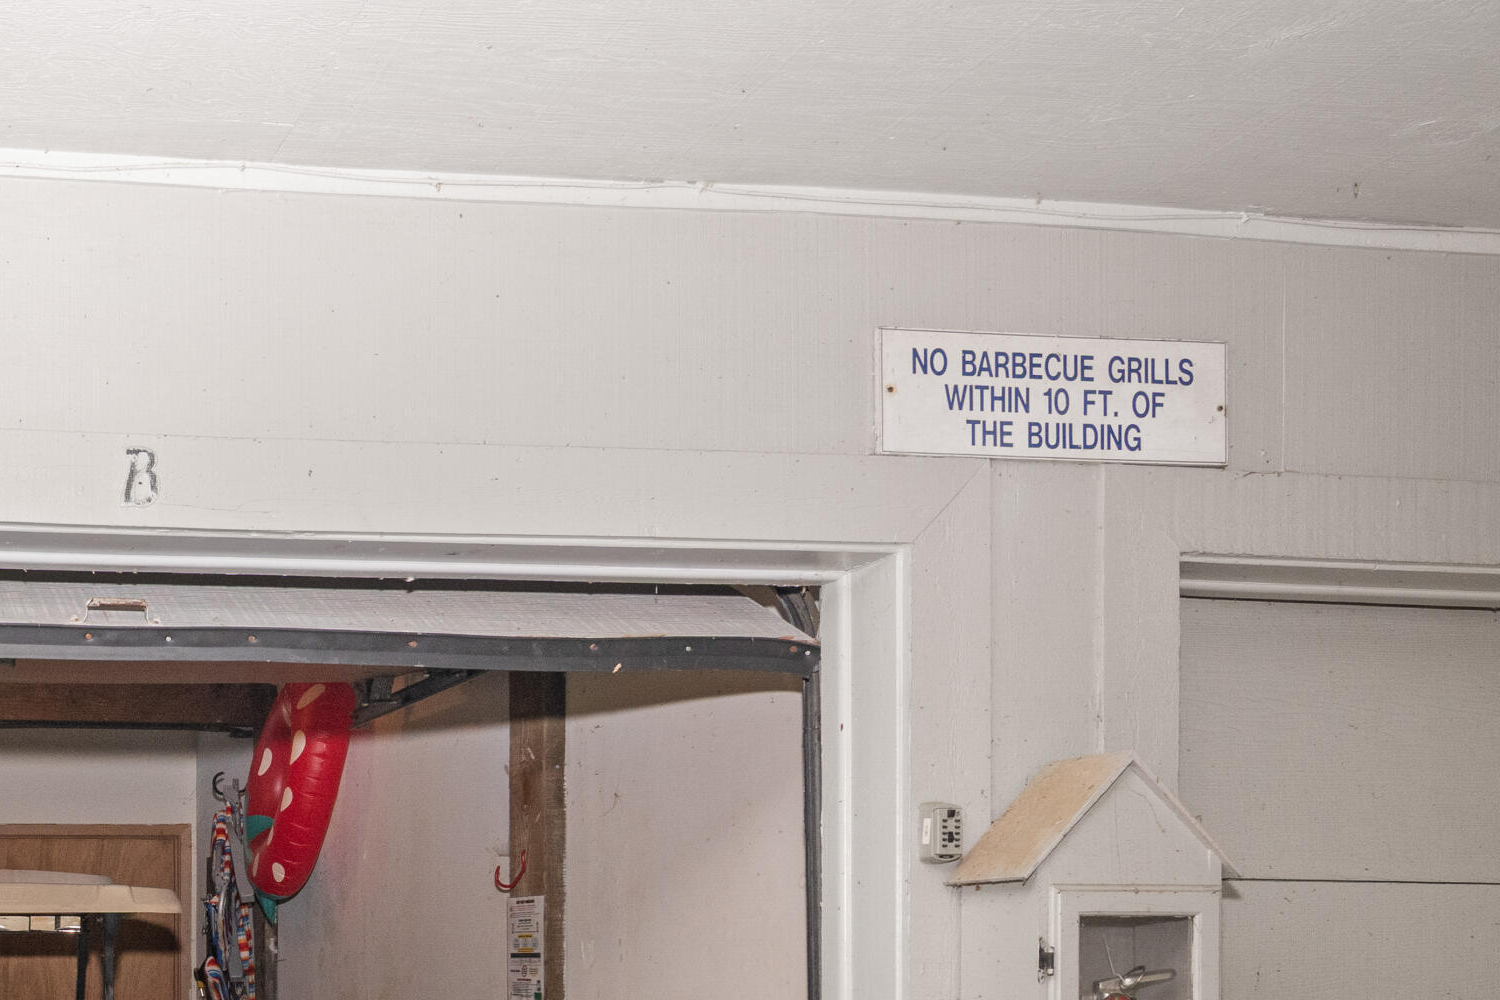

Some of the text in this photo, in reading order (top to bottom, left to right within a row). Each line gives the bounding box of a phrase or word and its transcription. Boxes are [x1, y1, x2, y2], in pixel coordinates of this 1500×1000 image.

[911, 347, 1195, 386] NO BARBECUE GRILLS
[945, 384, 1166, 418] WITHIN 10 FT. OF
[966, 419, 1142, 451] THE BUILDING
